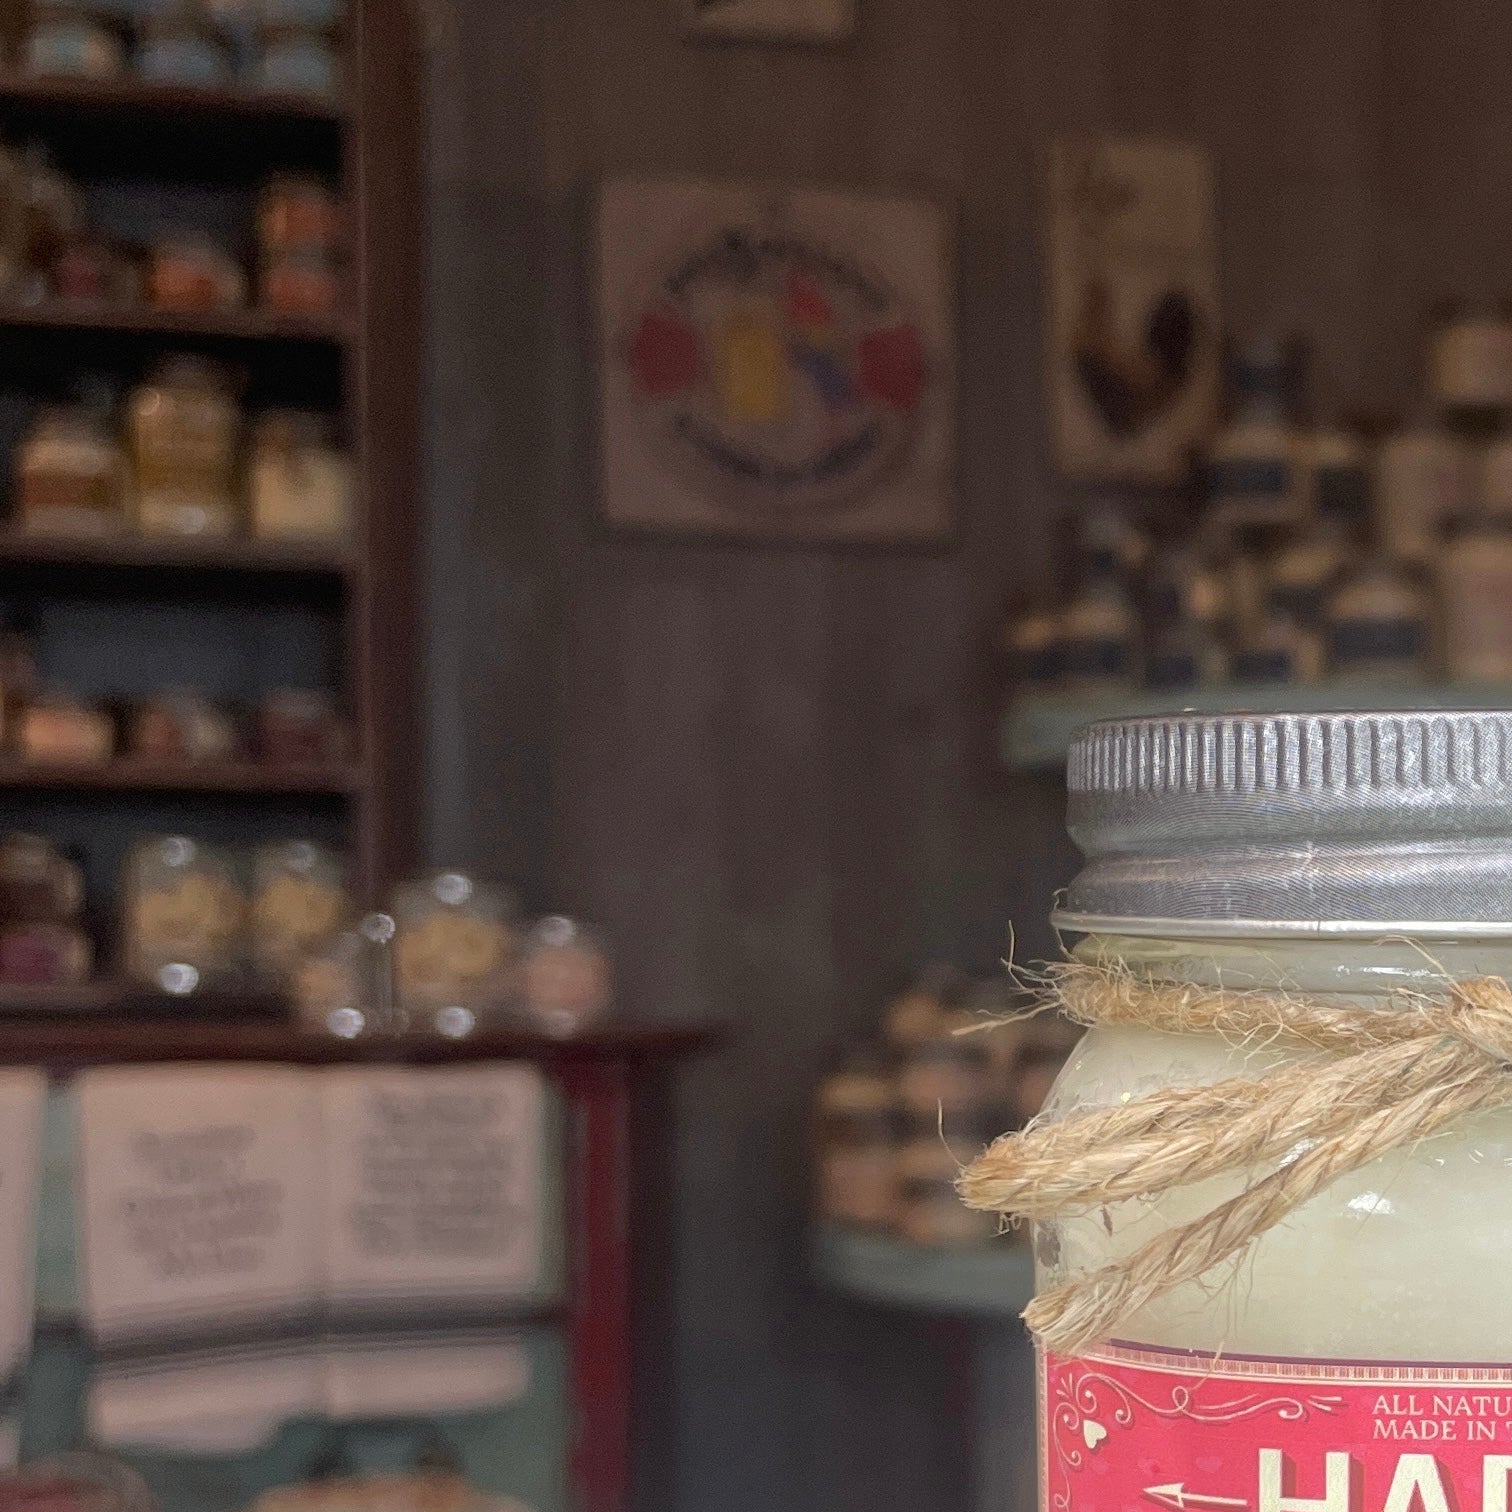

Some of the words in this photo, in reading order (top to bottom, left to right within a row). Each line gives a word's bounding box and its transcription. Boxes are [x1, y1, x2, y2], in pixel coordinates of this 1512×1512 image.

[1371, 1394, 1424, 1416] ALL
[1372, 1418, 1457, 1441] MADE
[1466, 1420, 1497, 1441] IN
